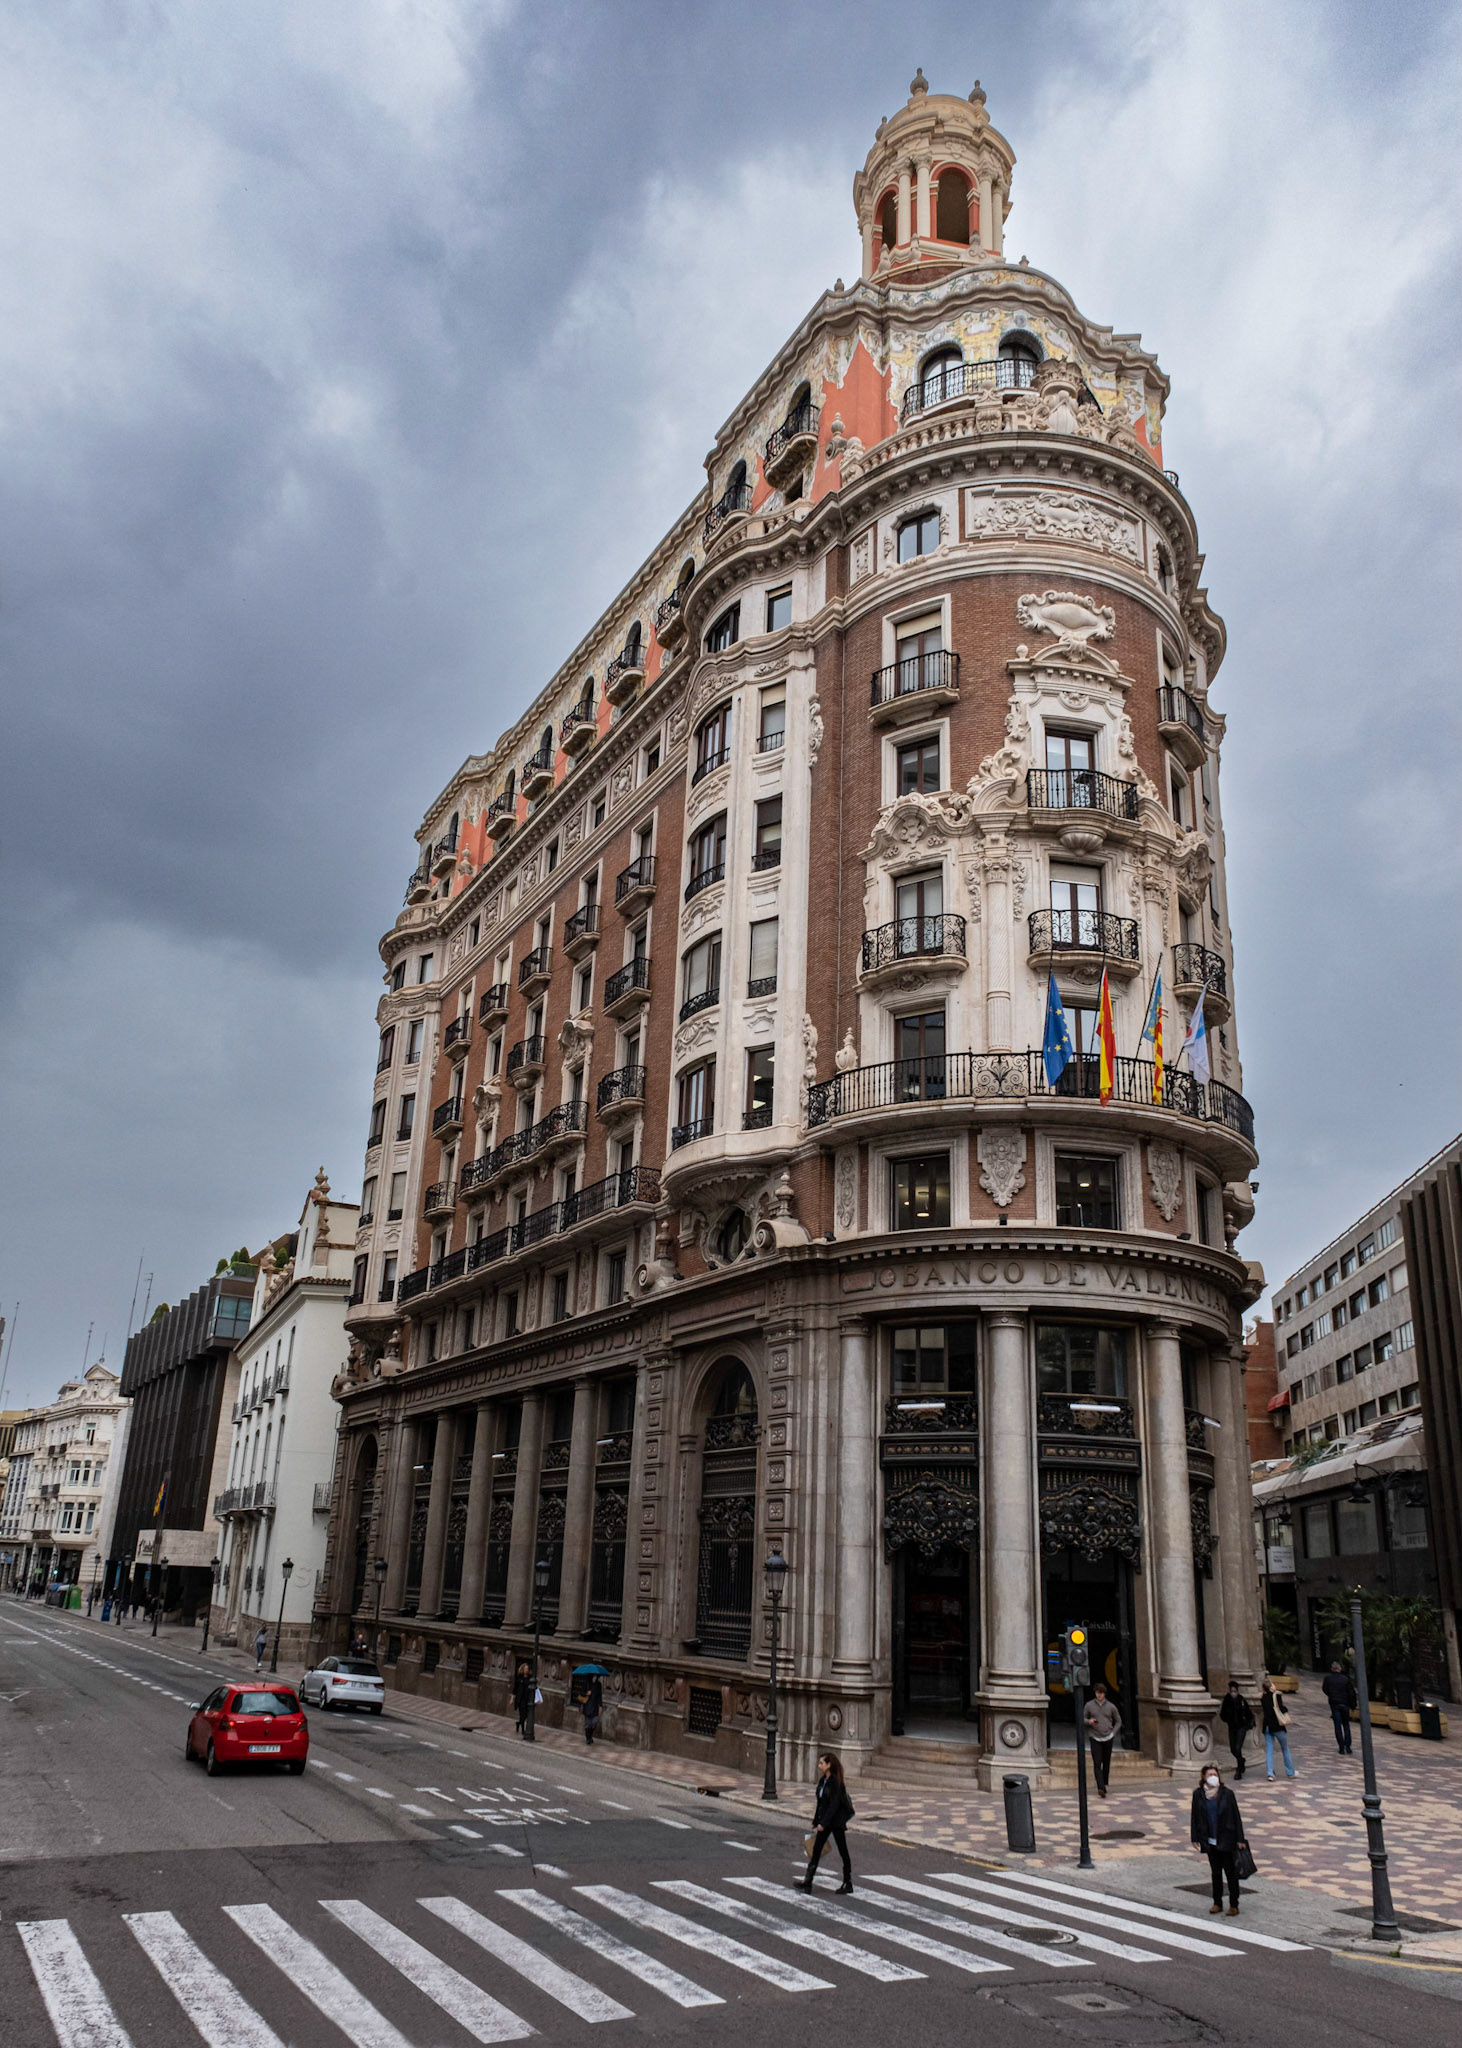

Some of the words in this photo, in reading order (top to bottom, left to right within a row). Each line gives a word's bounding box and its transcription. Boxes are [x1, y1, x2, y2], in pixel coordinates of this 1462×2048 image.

[903, 1261, 1024, 1287] BANCO
[1043, 1262, 1086, 1286] DE
[1103, 1264, 1221, 1311] VALENCIA
[1081, 1619, 1118, 1630] CaixaBa
[413, 1787, 550, 1801] TAXI
[463, 1808, 591, 1825] EMT
